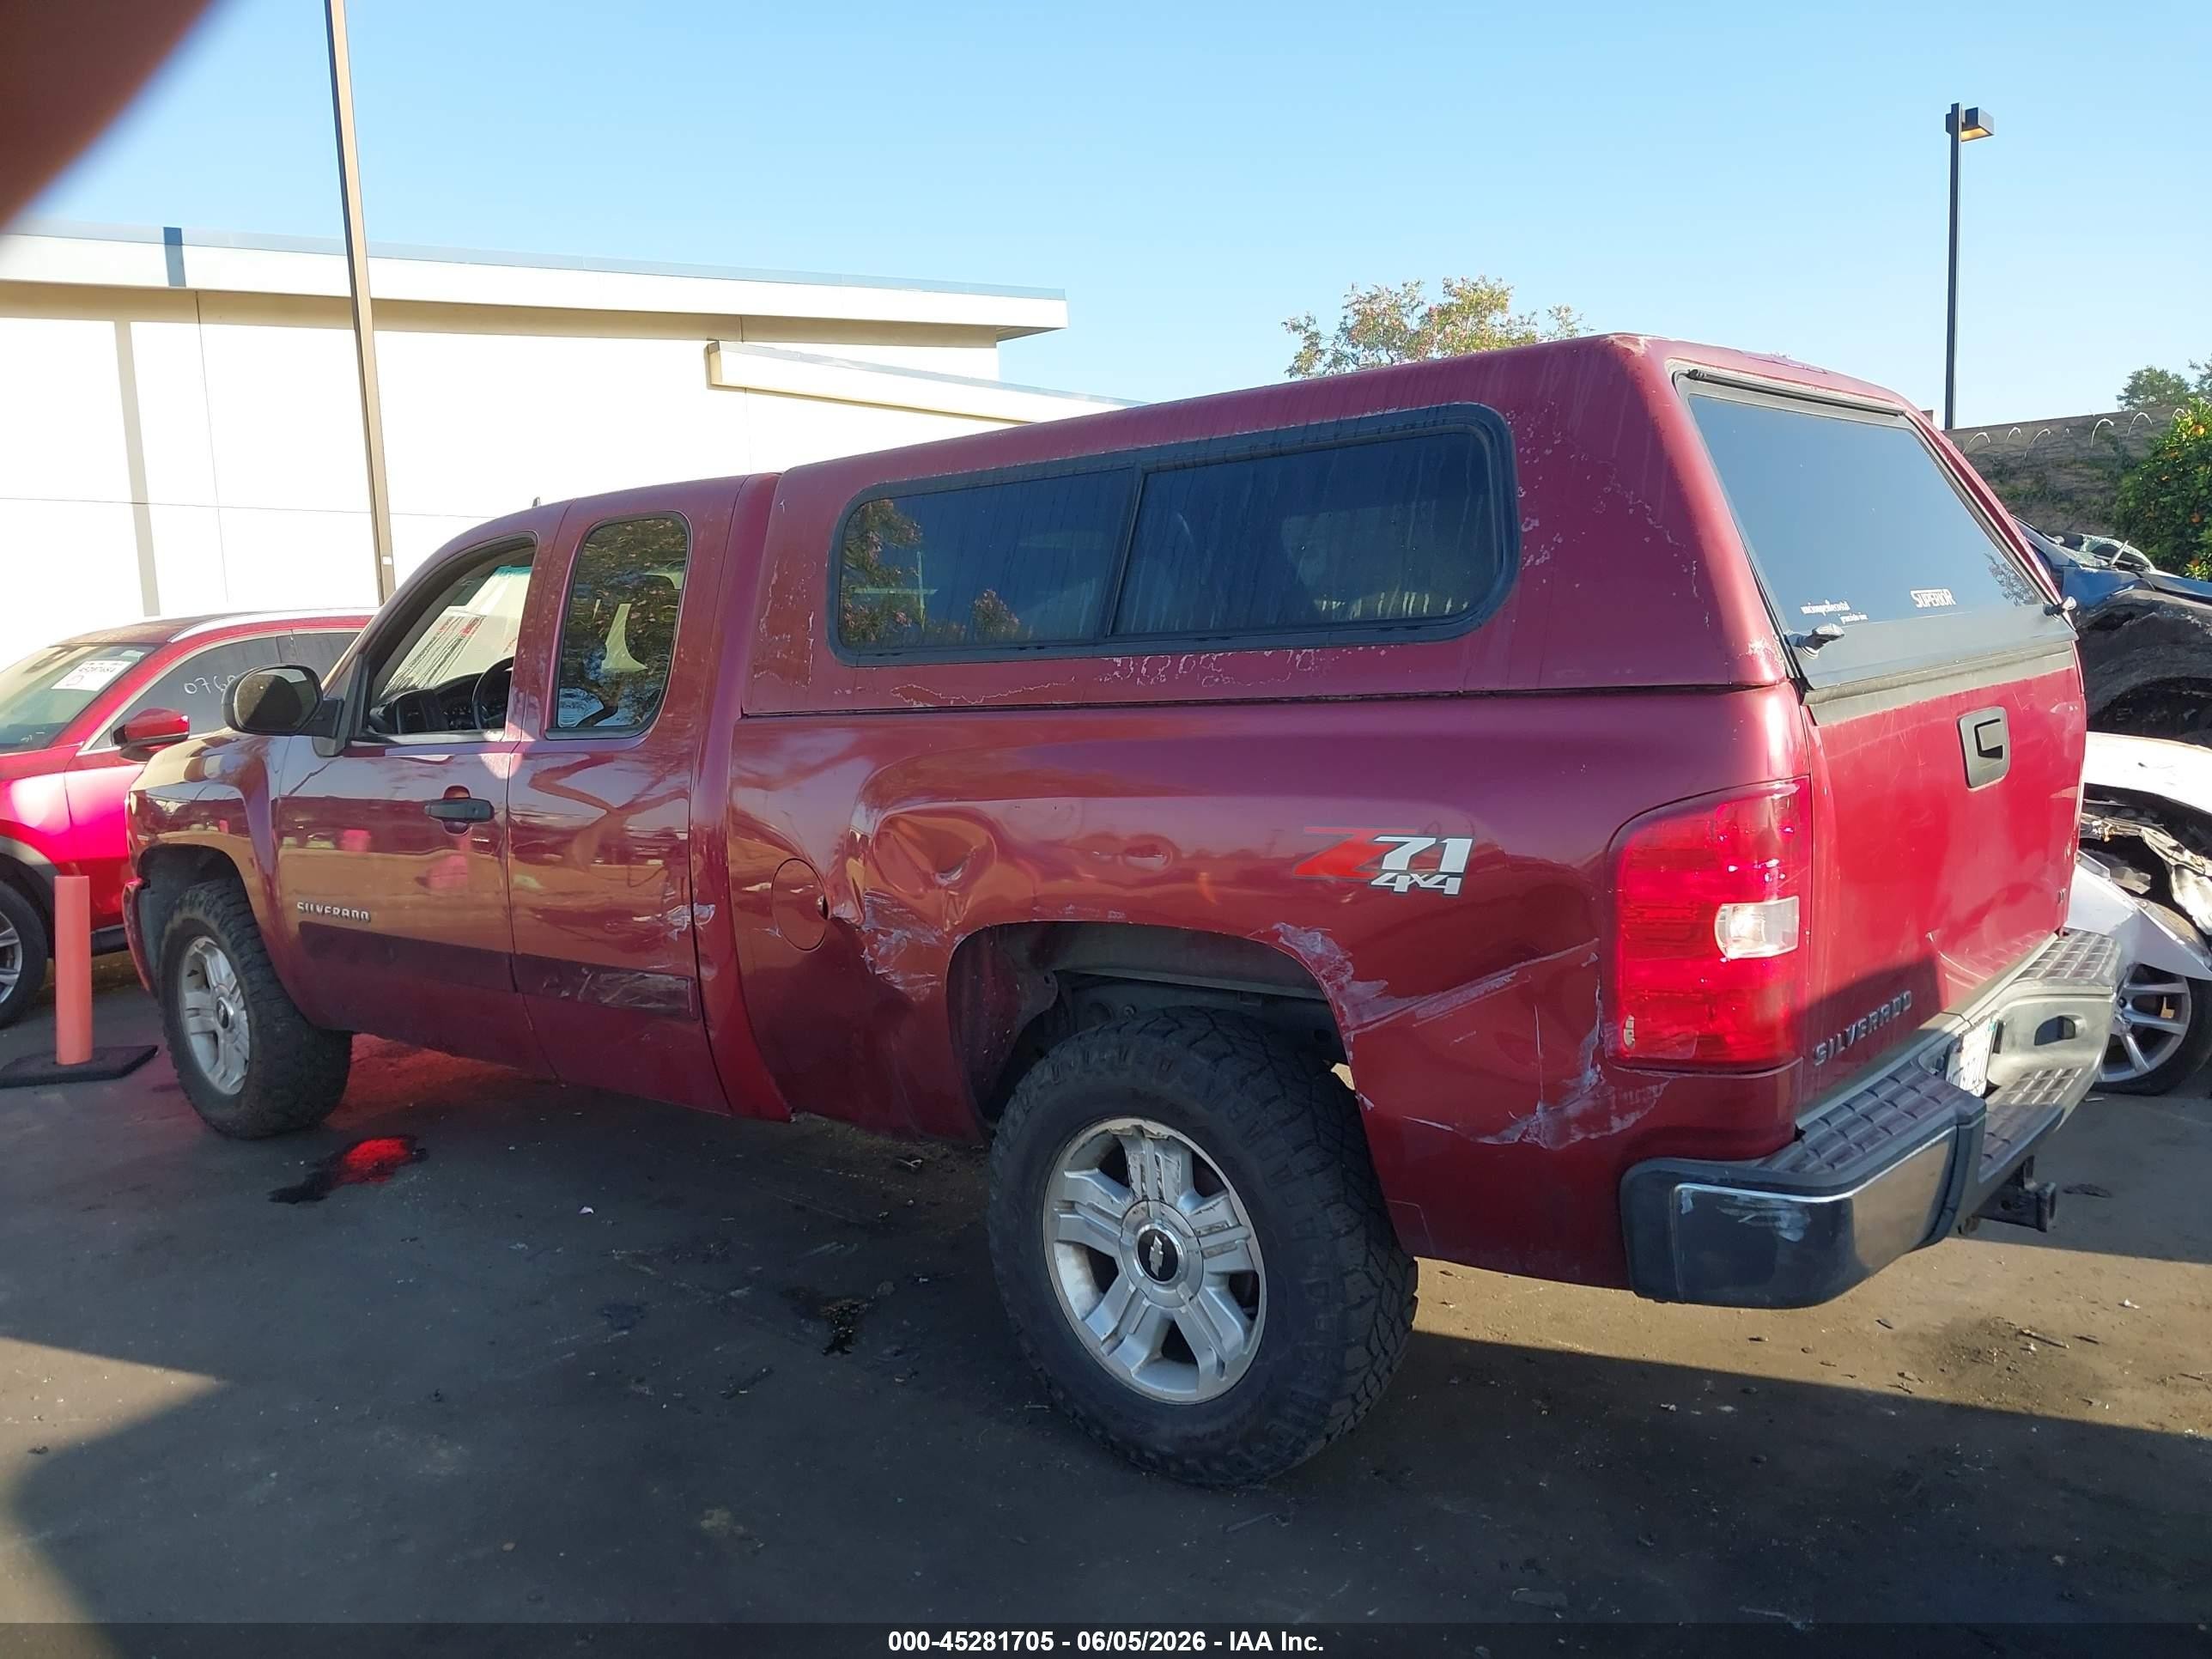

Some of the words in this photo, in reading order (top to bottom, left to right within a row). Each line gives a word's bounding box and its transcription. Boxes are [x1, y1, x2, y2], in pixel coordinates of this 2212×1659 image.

[1294, 826, 1473, 878] Z71
[296, 901, 371, 922] SILVERADO
[1814, 989, 1912, 1066] SILVERADO
